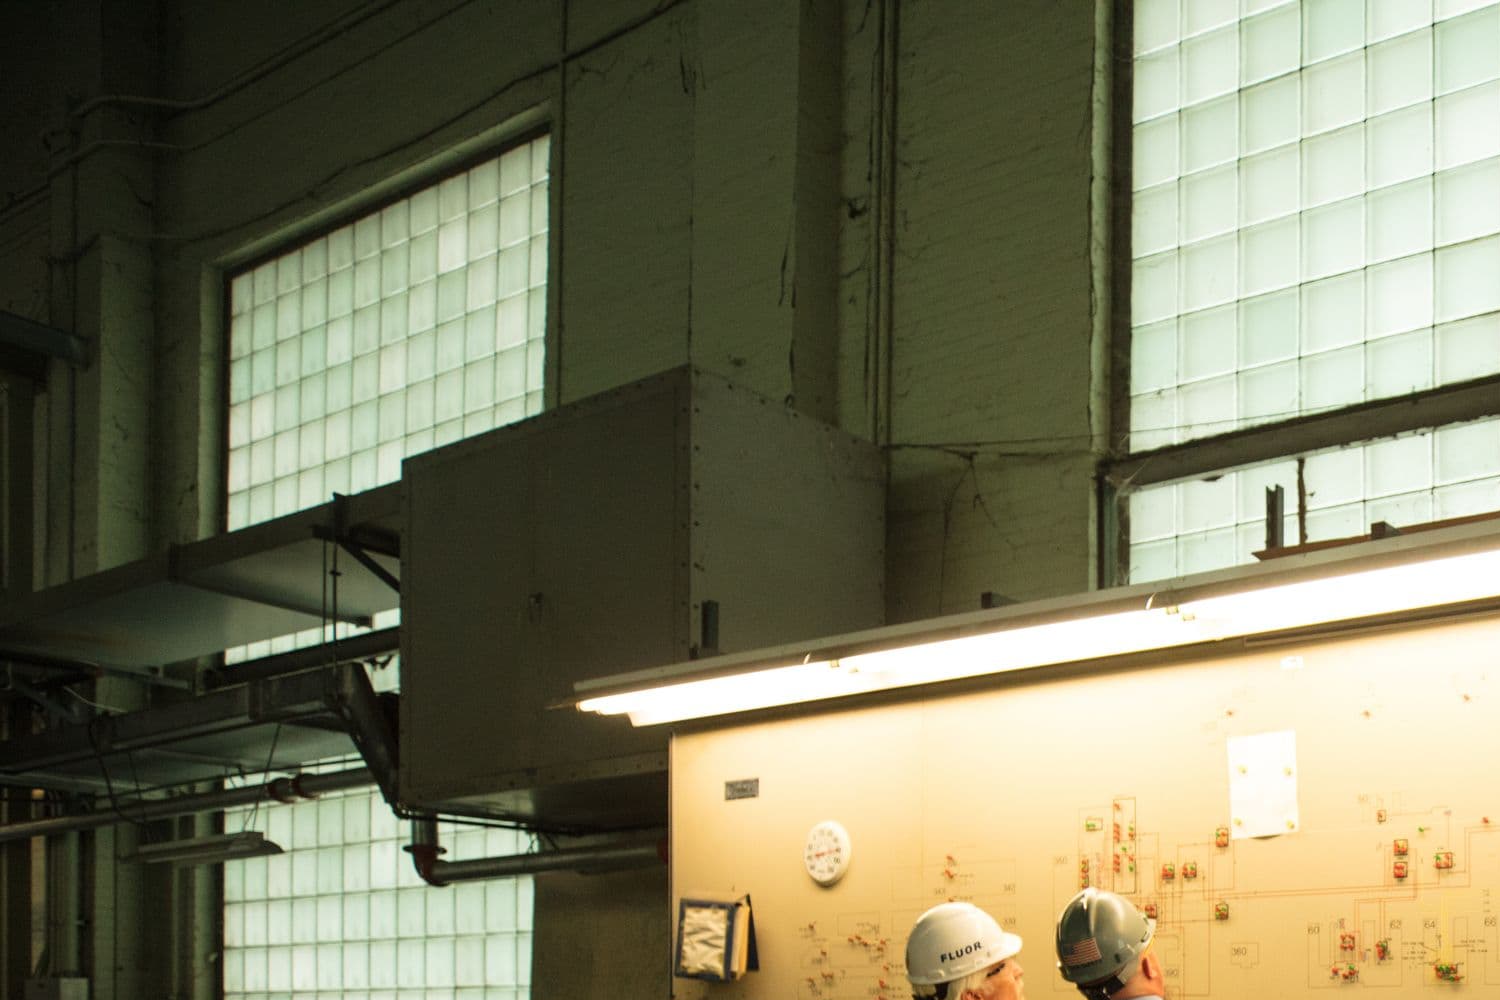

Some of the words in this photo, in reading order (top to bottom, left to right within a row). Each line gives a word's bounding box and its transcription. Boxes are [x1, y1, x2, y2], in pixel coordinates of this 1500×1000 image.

[1389, 919, 1402, 930] 62
[1423, 919, 1437, 930] 64
[1483, 916, 1497, 927] 66
[1306, 924, 1320, 935] 60
[940, 941, 982, 963] FLUOR
